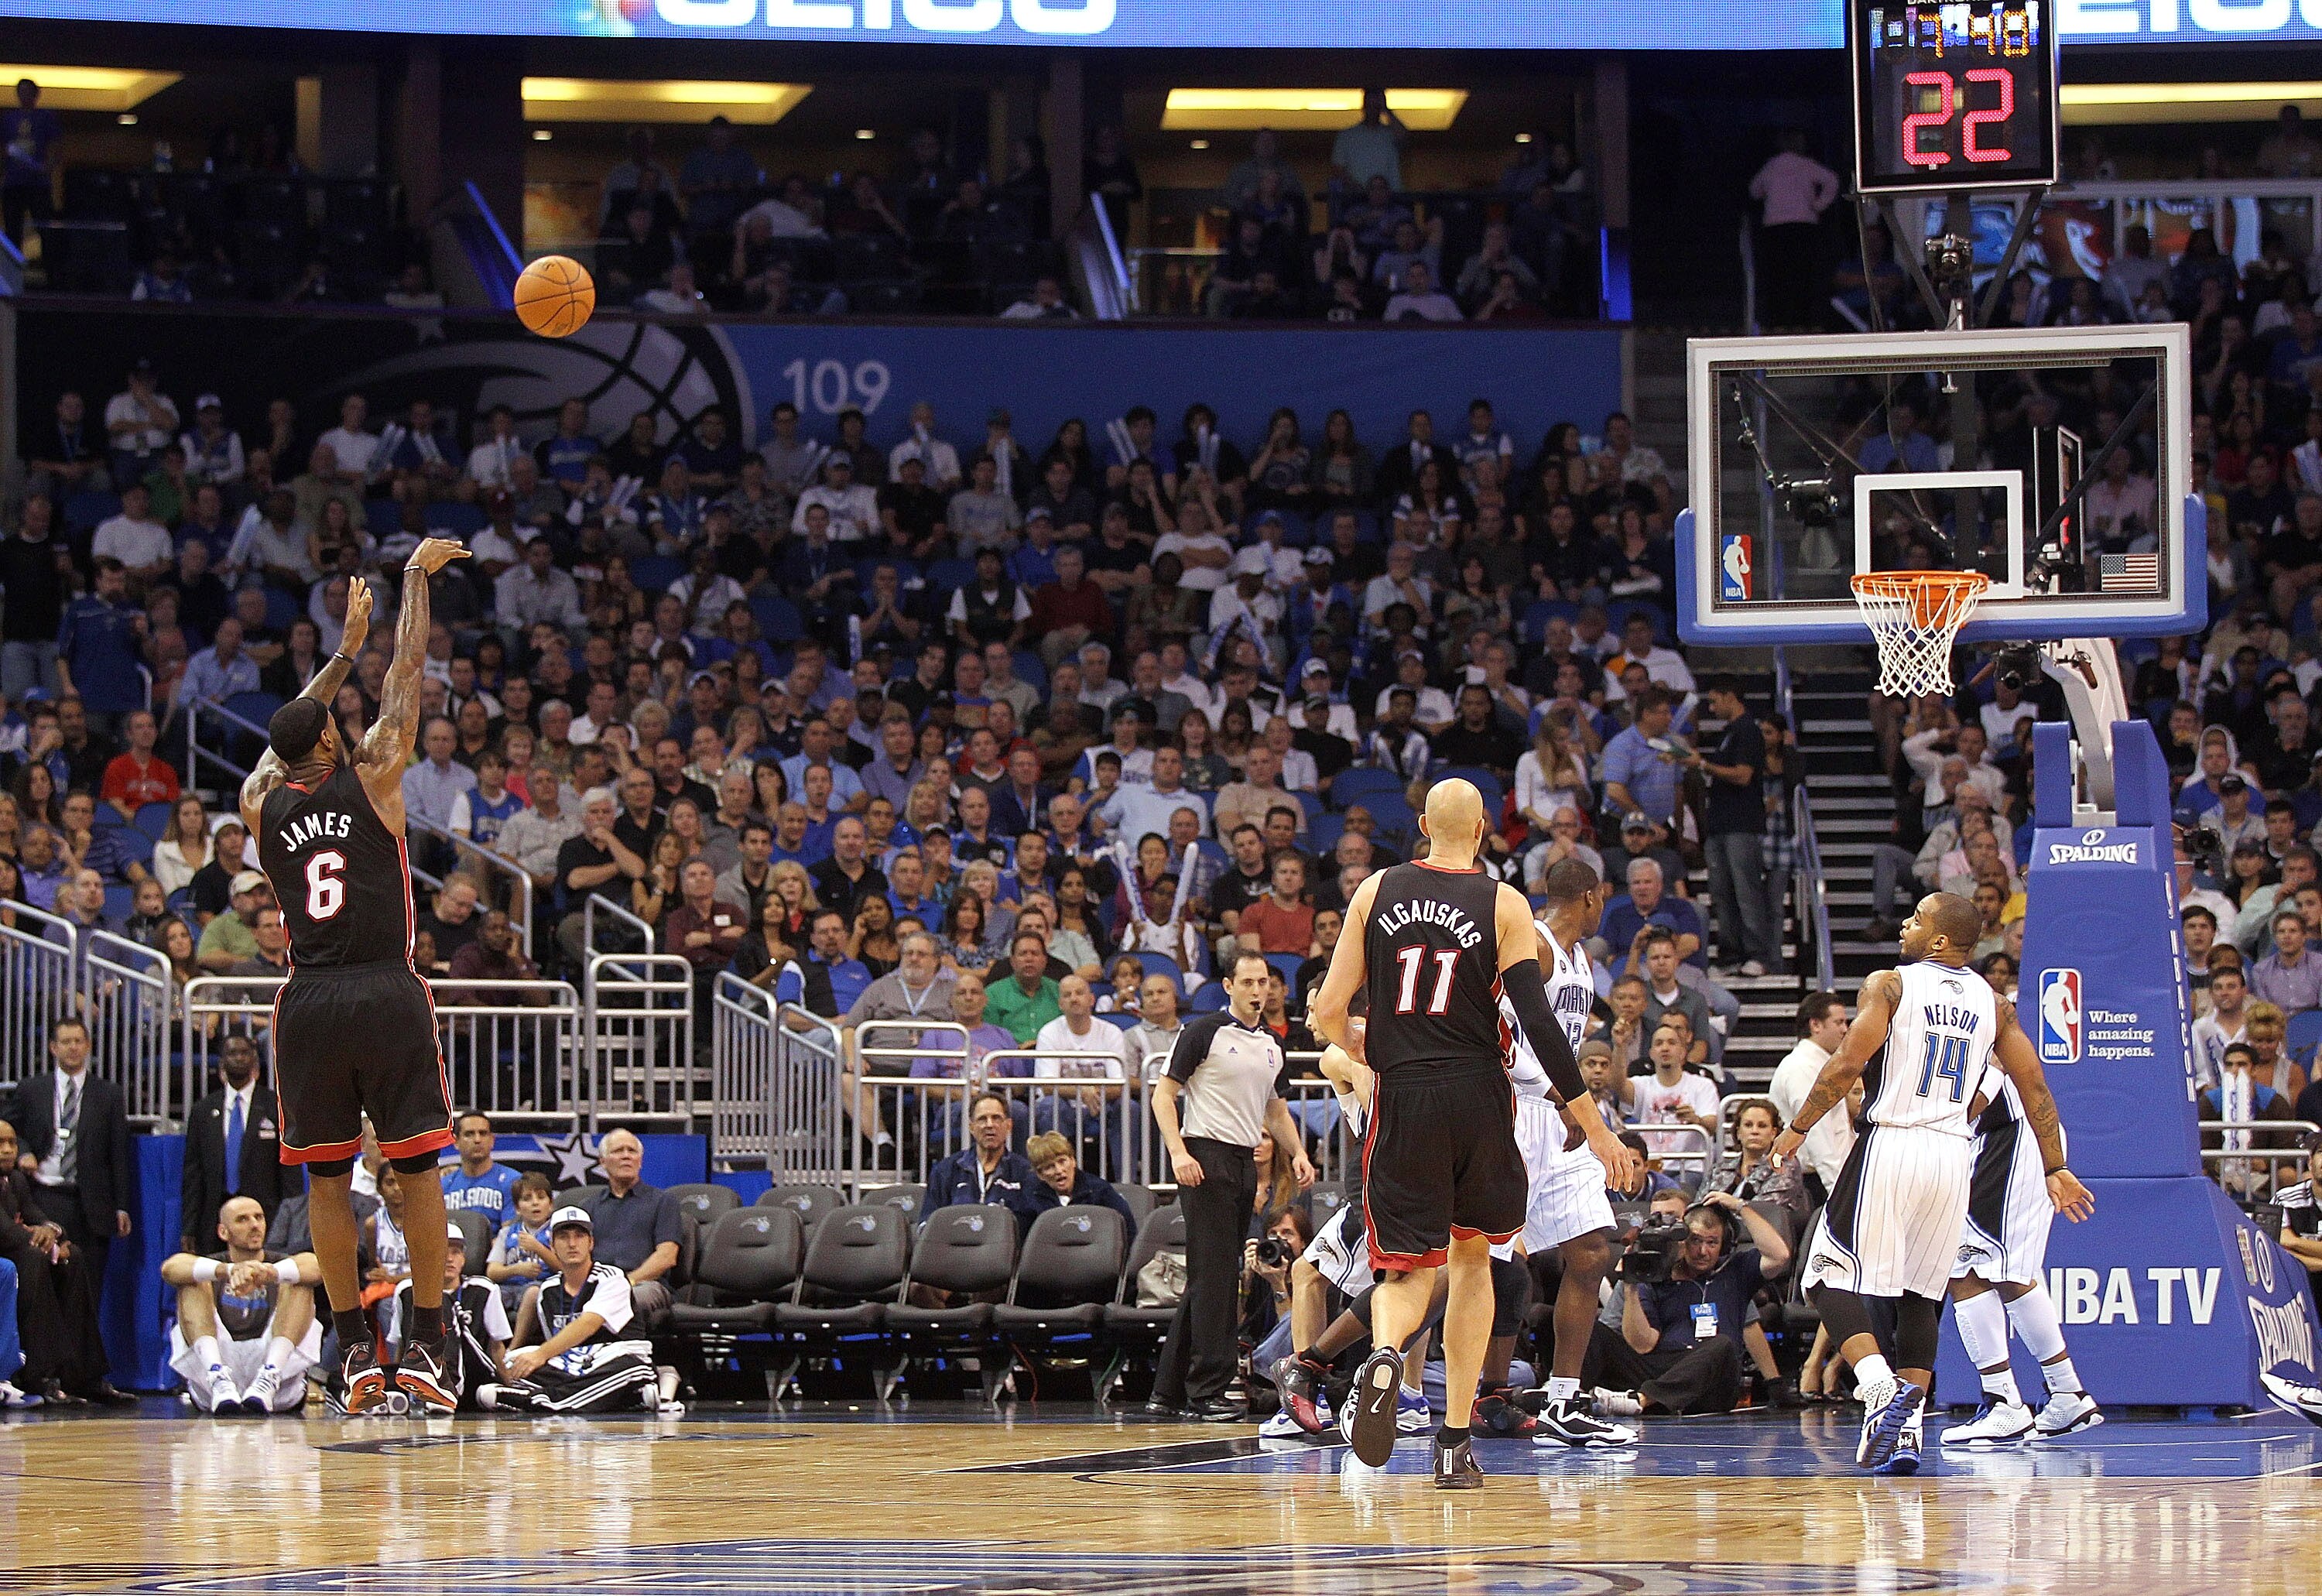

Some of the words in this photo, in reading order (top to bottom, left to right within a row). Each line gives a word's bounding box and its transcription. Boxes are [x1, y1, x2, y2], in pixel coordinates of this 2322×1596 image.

[1902, 68, 2014, 166] 22
[782, 358, 890, 415] 109
[1724, 587, 1742, 598] NBA
[279, 811, 353, 852] JAMES
[2049, 841, 2137, 865] SPALDING
[303, 848, 348, 923] 6
[1377, 899, 1482, 949] ILGAUSKAS
[1395, 944, 1463, 1016] 11
[1923, 1004, 1980, 1035] NELSON
[2087, 1010, 2138, 1023] Where
[2087, 1026, 2155, 1043] amazing
[1565, 1020, 1582, 1060] 12
[2044, 1043, 2067, 1057] NBA
[2087, 1044, 2155, 1061] happens.
[1915, 1030, 1971, 1104] 14
[2147, 1267, 2222, 1325] TV
[2247, 1290, 2315, 1375] SPALDING
